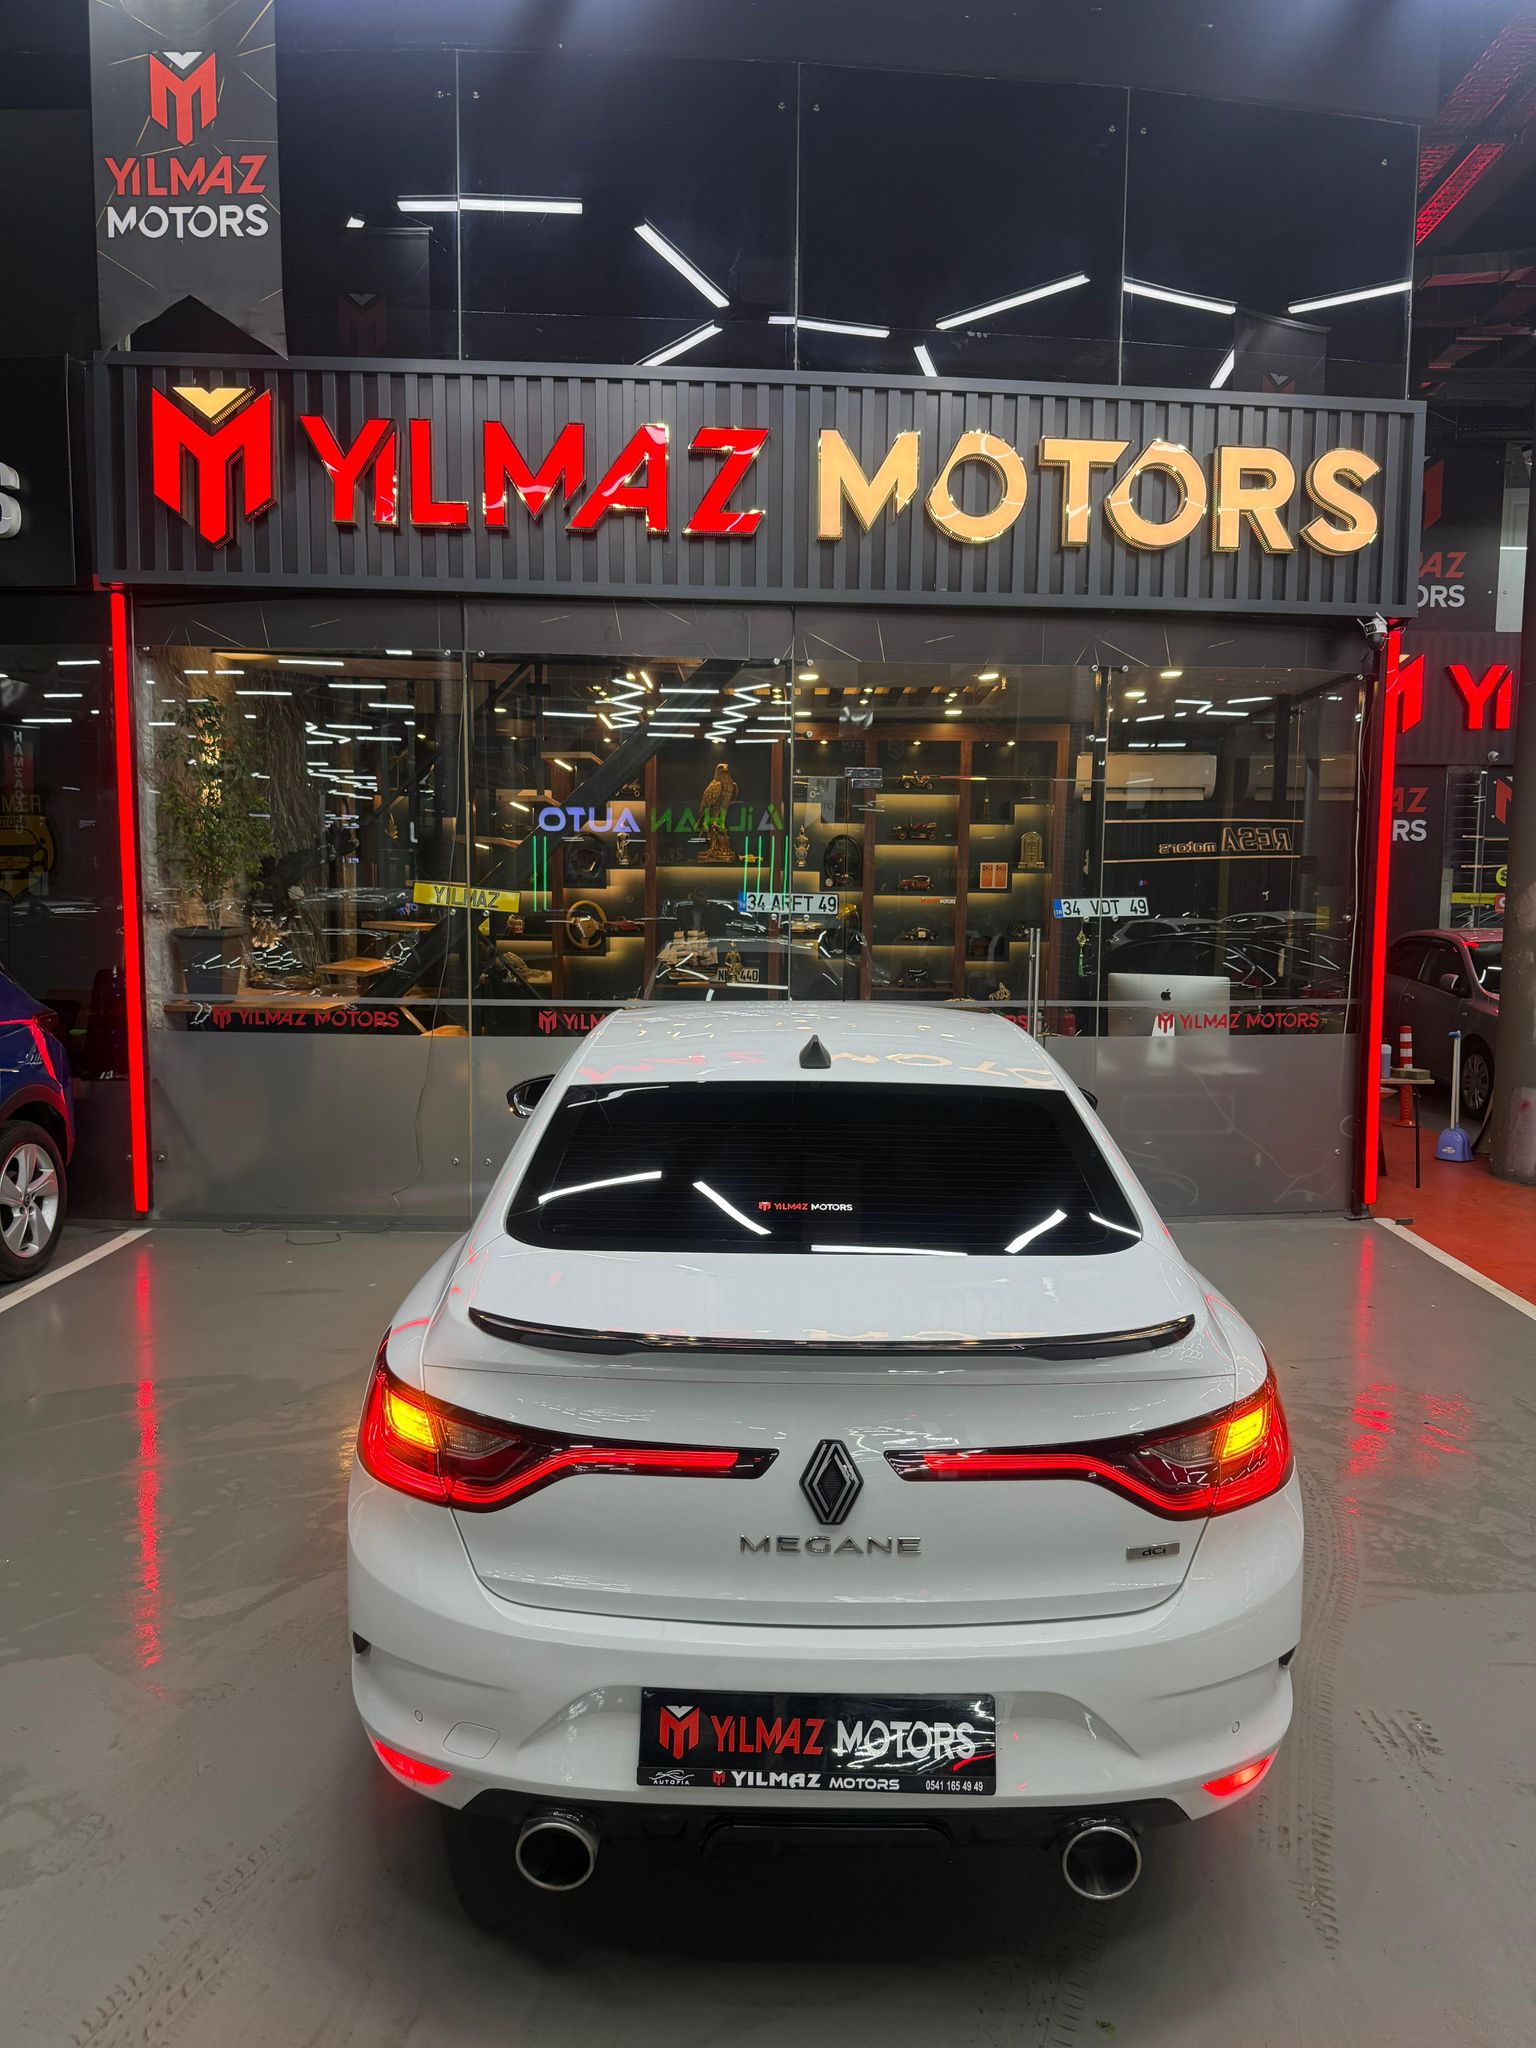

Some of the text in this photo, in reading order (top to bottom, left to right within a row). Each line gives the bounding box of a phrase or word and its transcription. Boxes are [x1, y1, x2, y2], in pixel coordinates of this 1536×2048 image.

[104, 155, 267, 196] YILMAZ
[107, 203, 269, 239] MOTORS
[300, 414, 773, 538] YILMAZ
[816, 427, 1383, 557] MOTORS
[433, 885, 500, 909] YILMAZ
[747, 894, 765, 911] 34
[818, 896, 837, 912] 49
[1063, 899, 1147, 916] 34 VDT 49
[237, 1007, 307, 1027] YILMAZ
[314, 1010, 401, 1028] MOTORS
[1179, 1011, 1241, 1030] YILMAZ
[1246, 1011, 1321, 1029] MOTORS
[774, 1203, 809, 1211] YILMAZ
[810, 1203, 853, 1212] MOTORS
[739, 1534, 922, 1555] MEGANE
[709, 1714, 826, 1756] YILMAZ
[834, 1718, 979, 1761] MOTORS
[731, 1770, 821, 1789] YILMAZ
[828, 1776, 901, 1791] MOTORS
[925, 1779, 984, 1792] 0541 165 49 49
